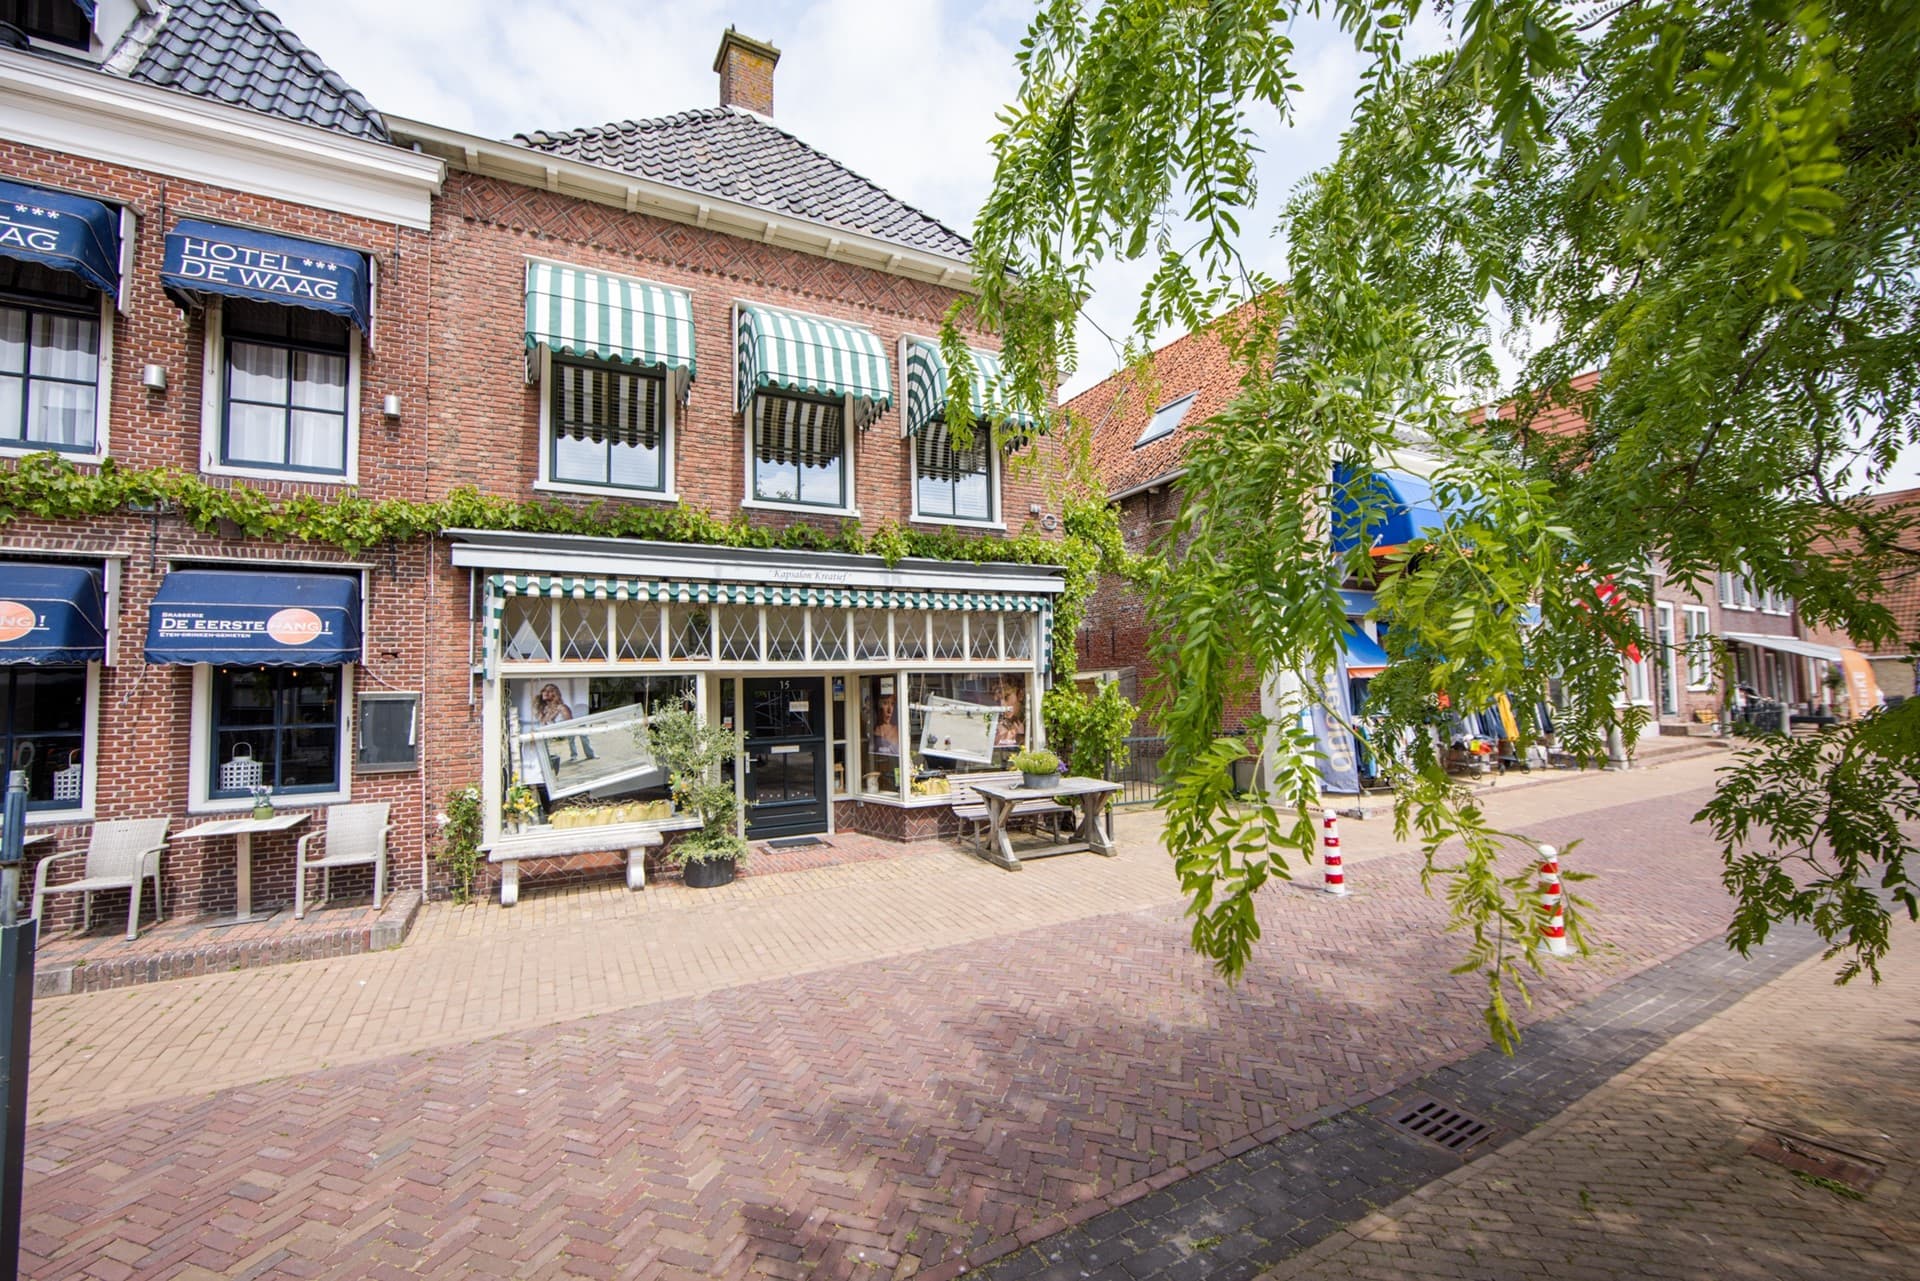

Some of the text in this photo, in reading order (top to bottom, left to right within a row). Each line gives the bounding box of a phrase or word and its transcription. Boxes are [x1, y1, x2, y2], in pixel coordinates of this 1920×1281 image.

[184, 238, 300, 273] HOTEL
[179, 259, 337, 300] DE WAAG
[161, 618, 188, 630] DE
[195, 620, 265, 631] EERSTE
[779, 680, 790, 690] 15
